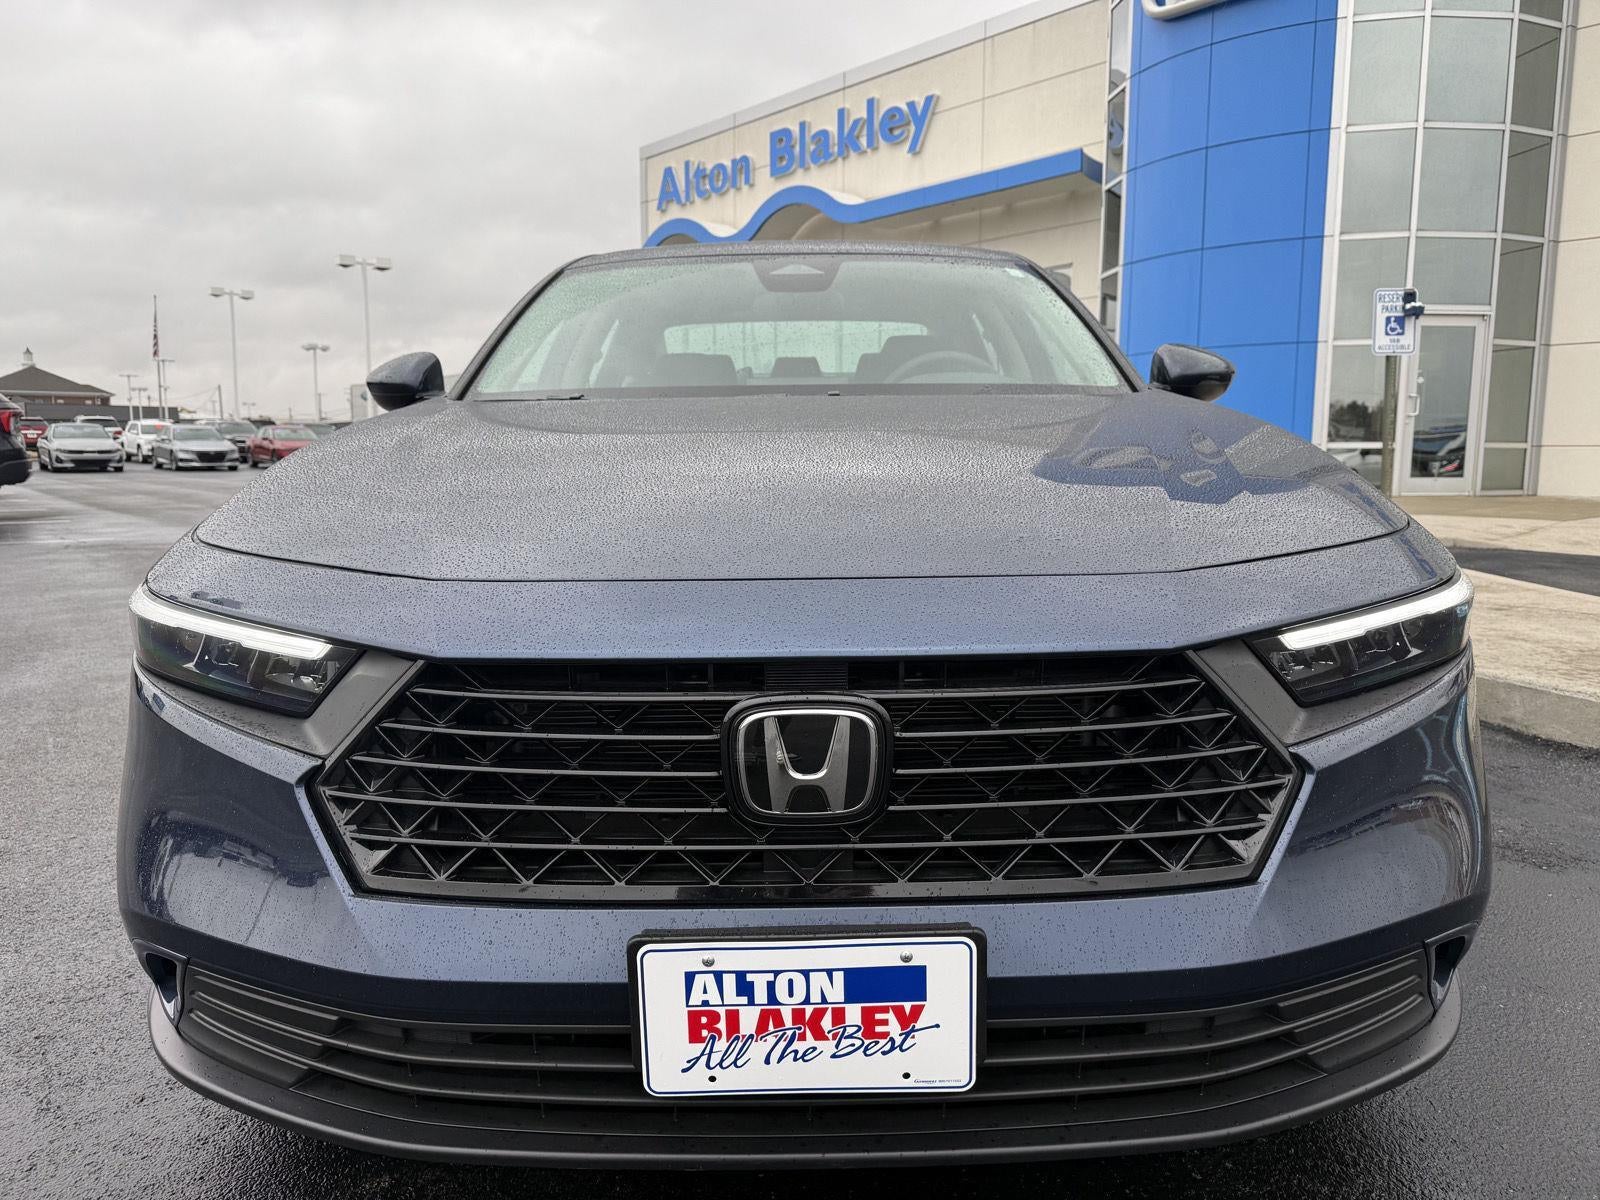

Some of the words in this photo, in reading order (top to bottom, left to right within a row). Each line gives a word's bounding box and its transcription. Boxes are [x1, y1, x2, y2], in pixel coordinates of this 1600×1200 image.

[656, 154, 752, 211] Alton
[769, 93, 939, 179] Blakley
[688, 970, 845, 1006] ALTON
[687, 1004, 926, 1044] BLAKLEY
[681, 1034, 755, 1074] All
[751, 1026, 824, 1066] The
[827, 1023, 941, 1059] Best
